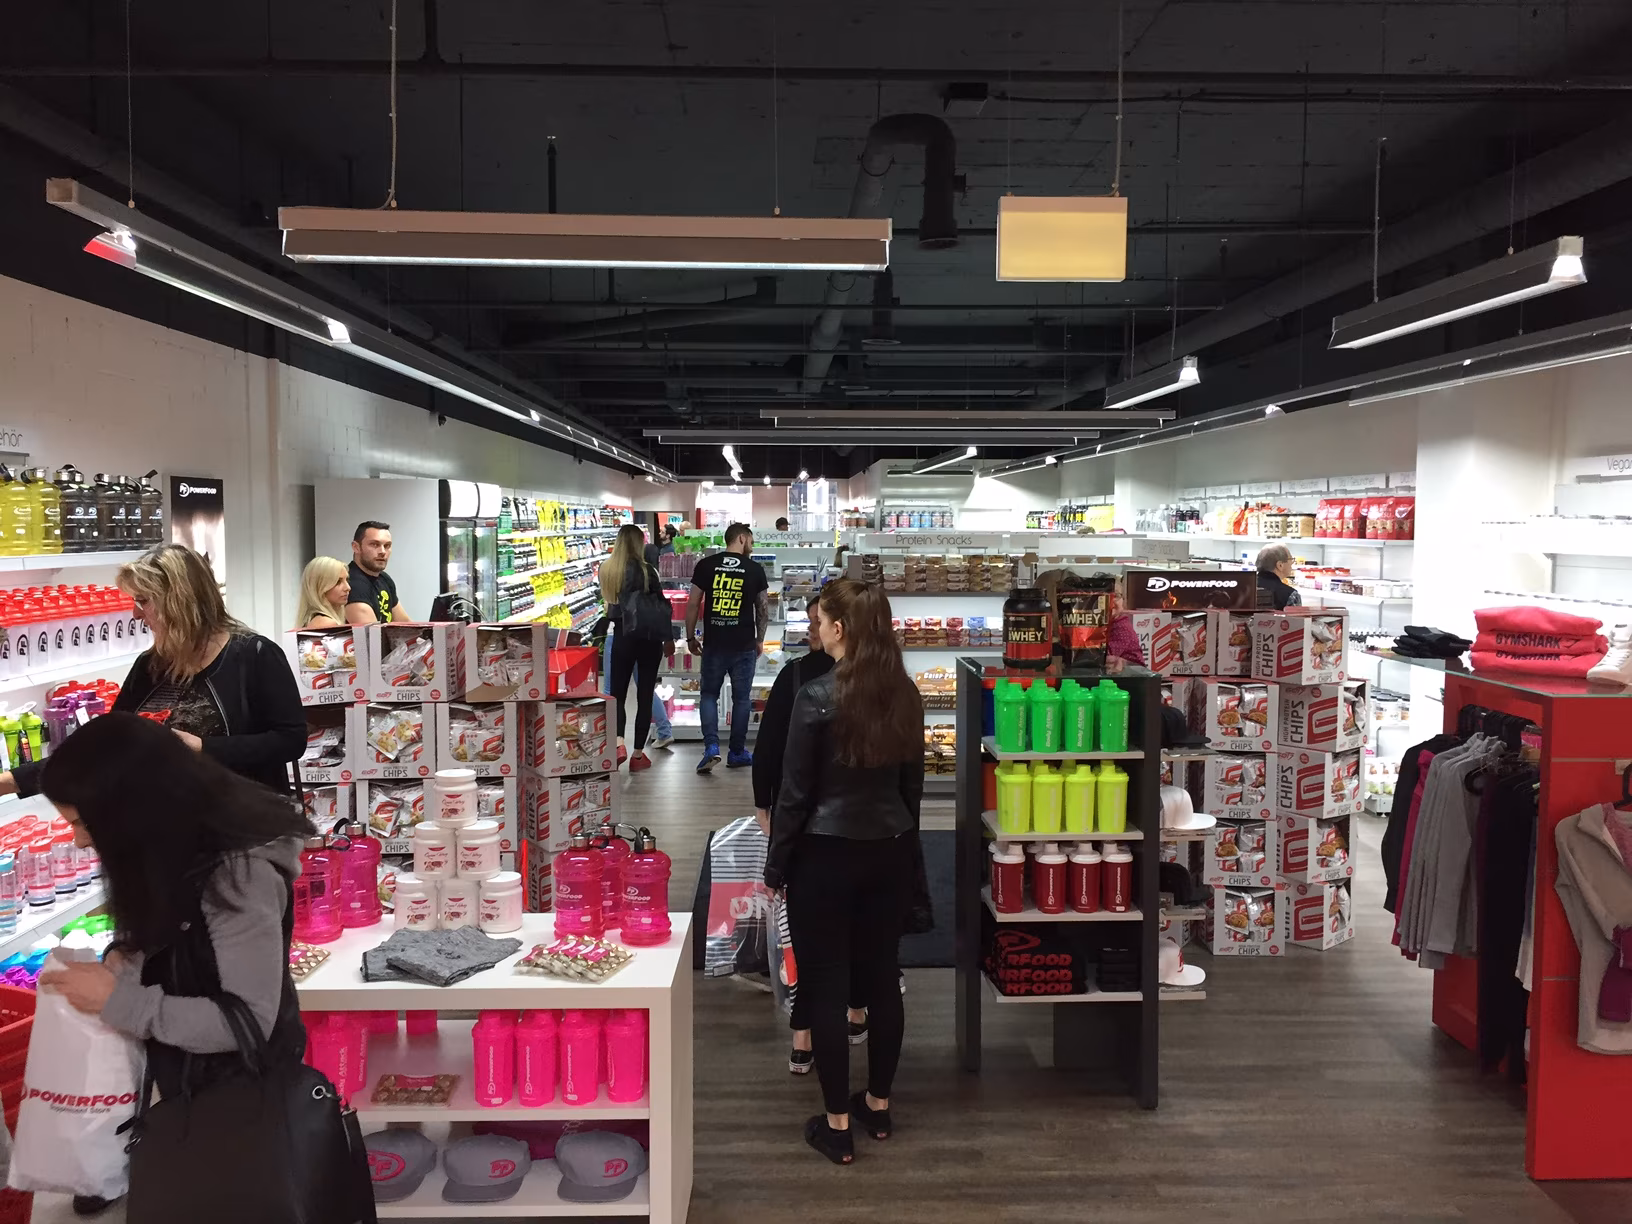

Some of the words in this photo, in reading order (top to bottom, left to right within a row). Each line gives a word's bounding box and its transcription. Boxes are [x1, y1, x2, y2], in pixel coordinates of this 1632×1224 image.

[755, 531, 803, 541] Superfoods
[895, 534, 932, 545] Protein
[936, 534, 972, 545] Snacks
[712, 572, 744, 590] the
[1171, 579, 1238, 588] POWERFOOD
[712, 589, 743, 599] store
[712, 599, 742, 612] you
[1066, 614, 1101, 624] WHEY
[1012, 631, 1042, 641] WHEY
[1496, 632, 1561, 649] GYMSHARK
[1262, 634, 1274, 677] CHIPS
[318, 694, 344, 704] CHIPS
[396, 692, 420, 701] CHIPS
[1290, 700, 1304, 743] CHIPS
[383, 769, 408, 777] CHIPS
[476, 768, 490, 776] IPS
[570, 765, 593, 773] CHIPS
[306, 774, 331, 782] CHIPS
[1280, 766, 1293, 809] CHIPS
[1007, 953, 1073, 966] RFOOD
[1006, 982, 1073, 994] RFOOD
